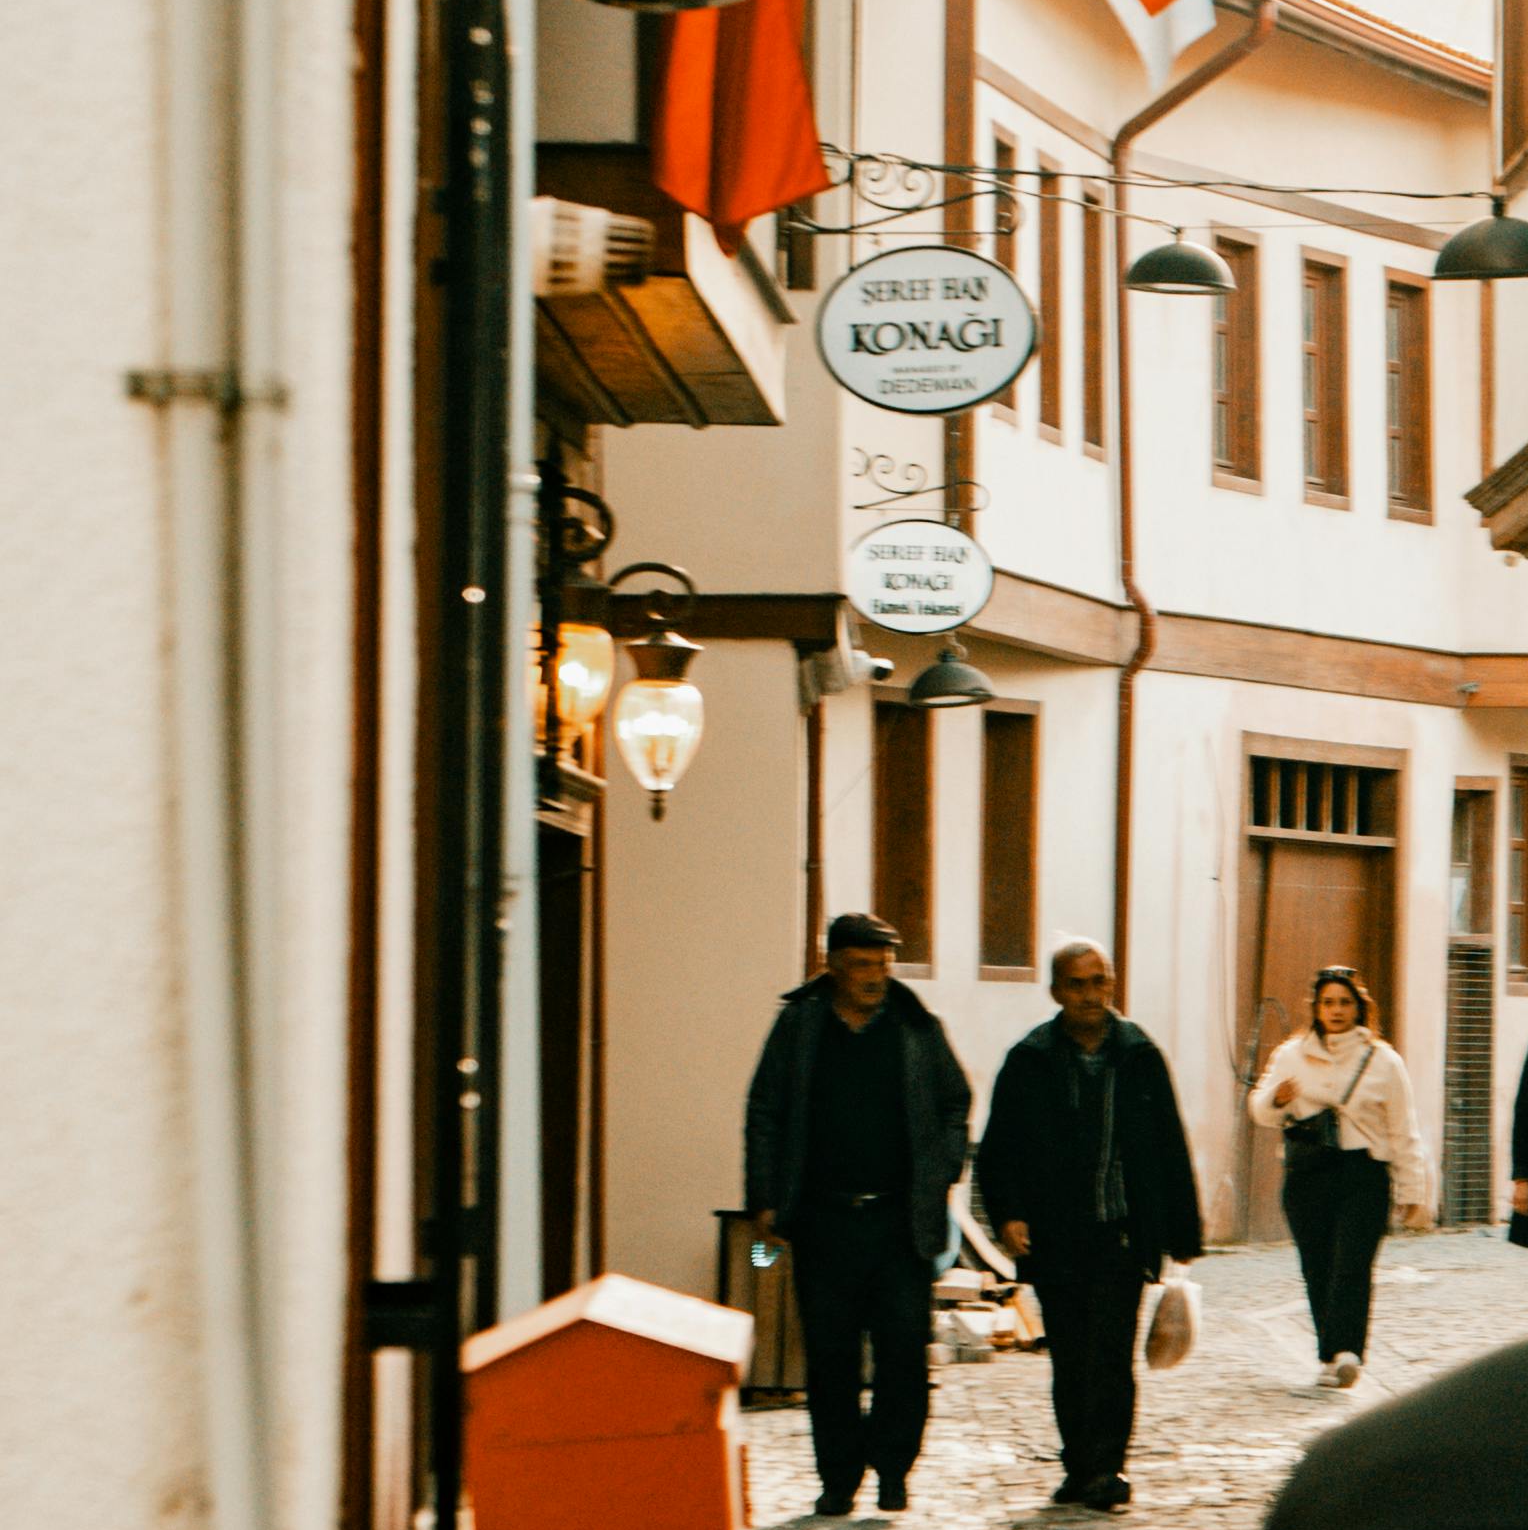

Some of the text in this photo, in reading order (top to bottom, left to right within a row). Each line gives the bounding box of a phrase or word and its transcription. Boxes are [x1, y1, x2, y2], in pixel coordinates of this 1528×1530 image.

[941, 276, 989, 301] HAN
[848, 312, 1004, 355] KONAĞI
[878, 377, 977, 394] DEDEMAN
